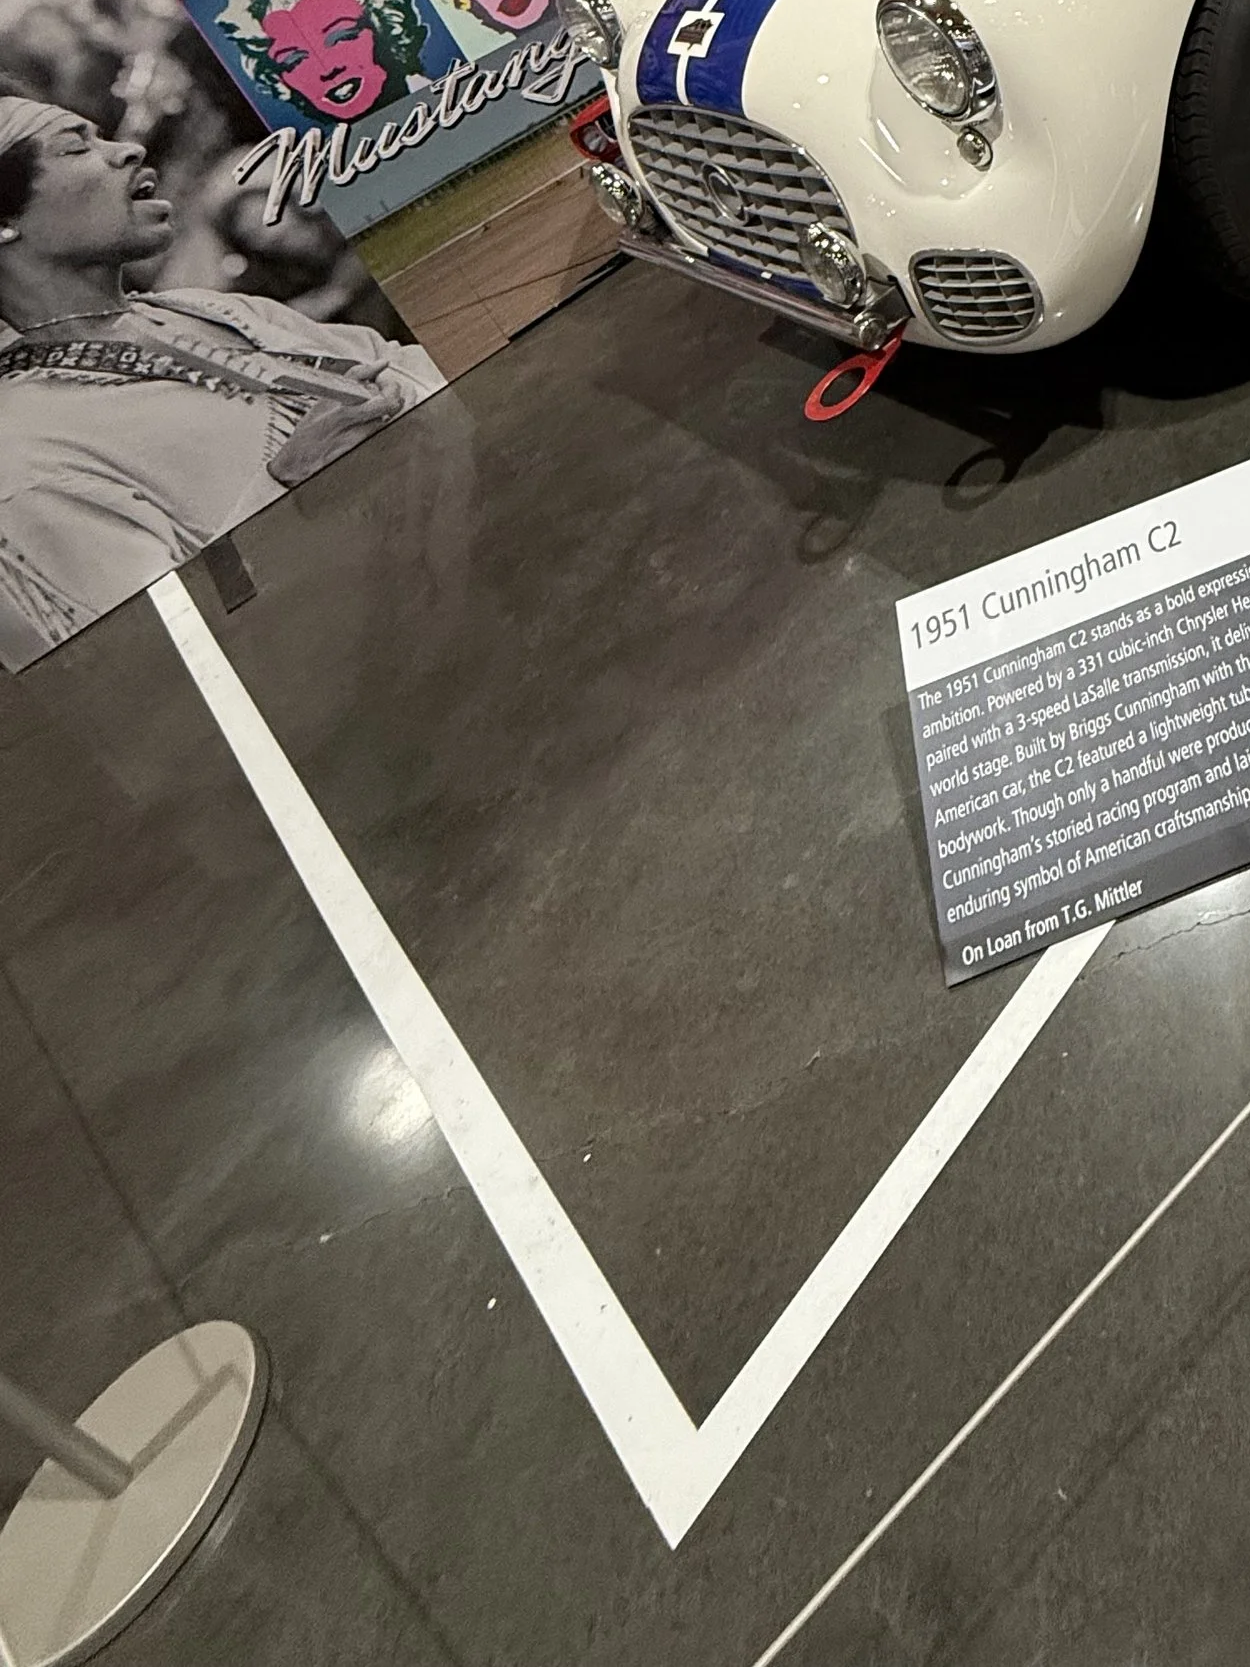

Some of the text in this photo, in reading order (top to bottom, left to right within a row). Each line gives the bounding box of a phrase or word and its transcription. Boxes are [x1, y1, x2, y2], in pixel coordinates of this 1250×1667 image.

[232, 28, 587, 227] Mustang
[910, 520, 1182, 649] 1951 Cunningham C2
[916, 690, 942, 710] The
[945, 672, 978, 698] 1951
[982, 641, 1066, 683] Cunningham
[1067, 628, 1088, 649] C2
[1090, 611, 1134, 641] stands
[1135, 606, 1152, 623] as
[1153, 601, 1164, 615] a
[1164, 584, 1196, 611] bold
[922, 704, 984, 738] ambition.
[986, 674, 1044, 712] Powered
[1045, 670, 1062, 690] by
[1066, 666, 1075, 680] a
[1077, 651, 1103, 676] 331
[1107, 623, 1174, 663] cubic-inch
[1175, 603, 1228, 635] Chrysler
[942, 834, 1043, 889] Cunningham's
[1044, 811, 1094, 849] storied
[1095, 798, 1140, 828] racing
[1142, 773, 1202, 814] program
[1204, 755, 1232, 784] and
[946, 885, 1011, 923] enduring
[1012, 857, 1064, 899] symbol
[1066, 849, 1081, 874] of
[1084, 827, 1151, 868] American
[961, 879, 1142, 965] On Loan from T.G. Mittler
